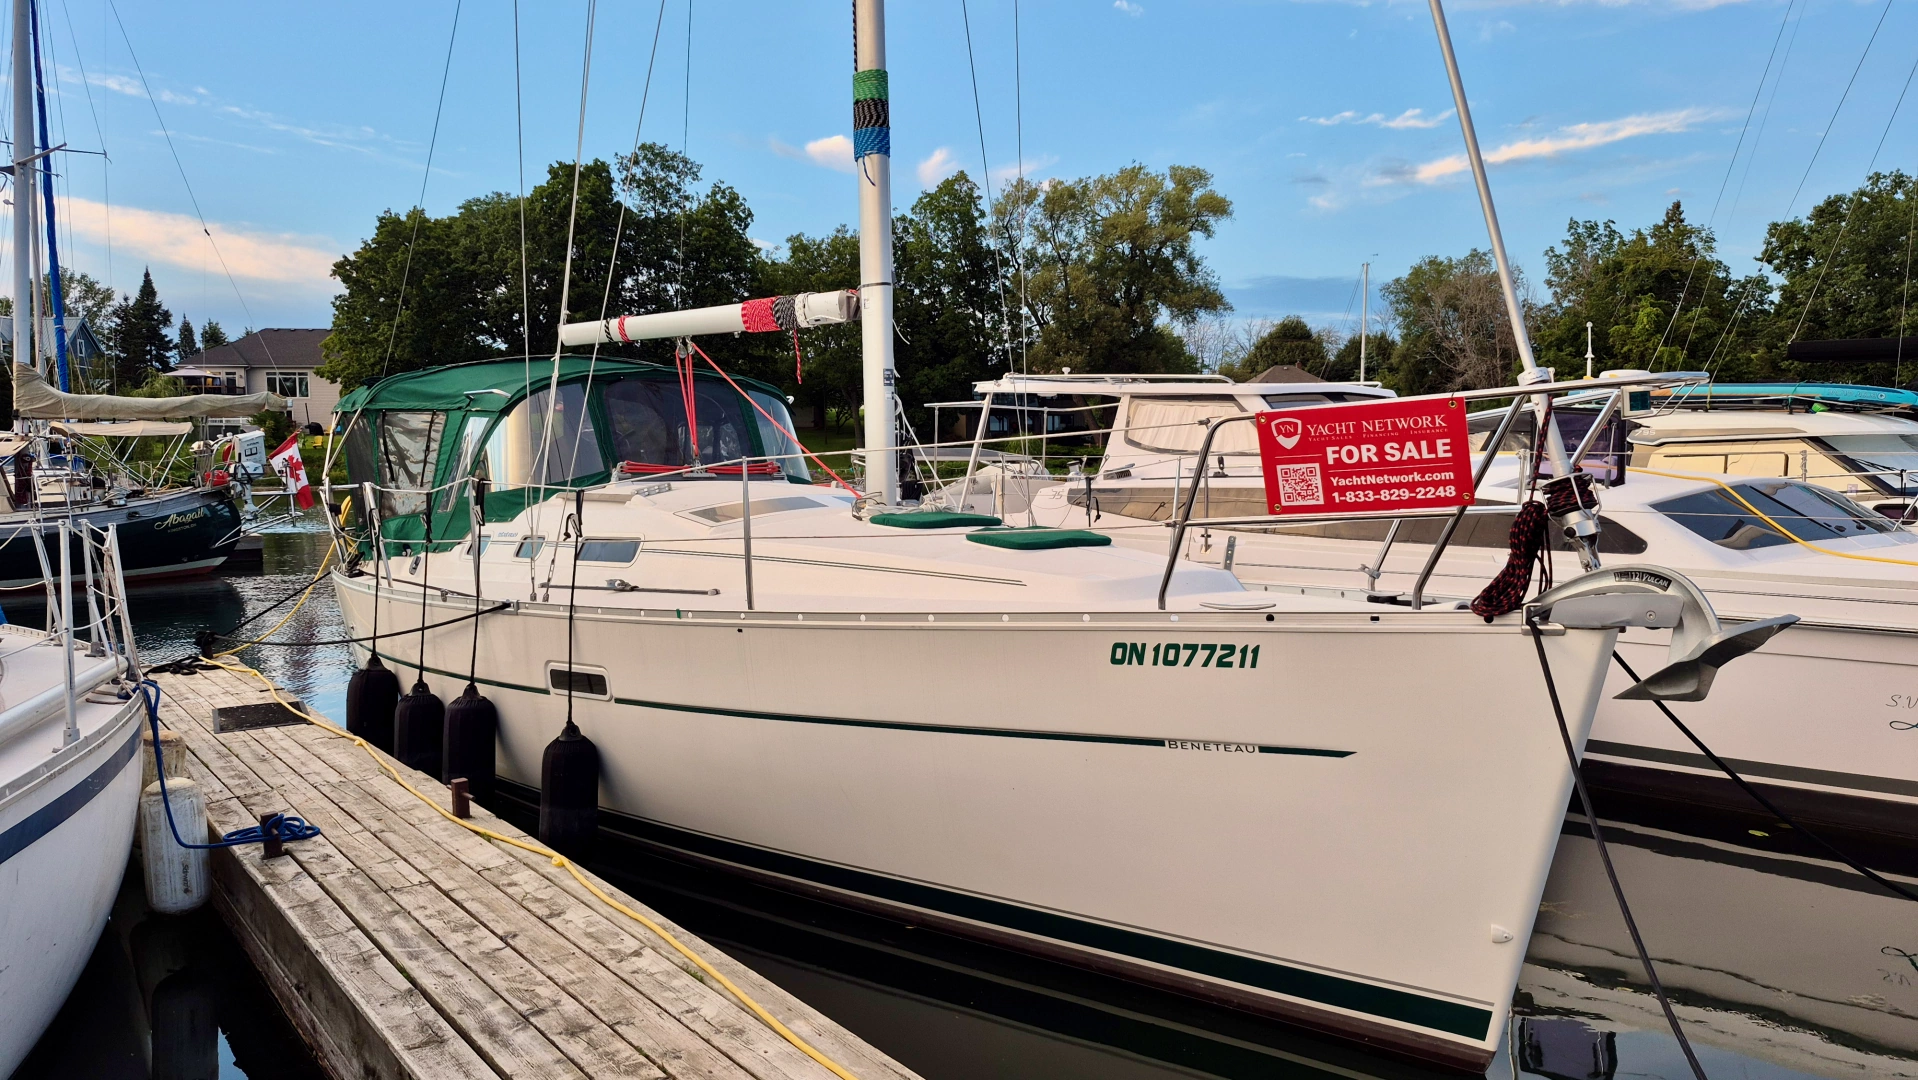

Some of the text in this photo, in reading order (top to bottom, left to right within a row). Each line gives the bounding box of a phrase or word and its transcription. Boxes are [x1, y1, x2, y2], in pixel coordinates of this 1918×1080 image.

[1279, 424, 1294, 433] YN
[1306, 414, 1448, 436] YACHT NETWORK
[1326, 438, 1453, 465] FOR SALE
[1330, 471, 1454, 486] YachtNetwork.com
[1332, 485, 1456, 503] 1-833-829-2248
[154, 506, 204, 530] Abagail
[1642, 573, 1669, 587] VULCAN
[1110, 642, 1260, 668] ON 1077211
[1168, 740, 1256, 754] BENETEAU
